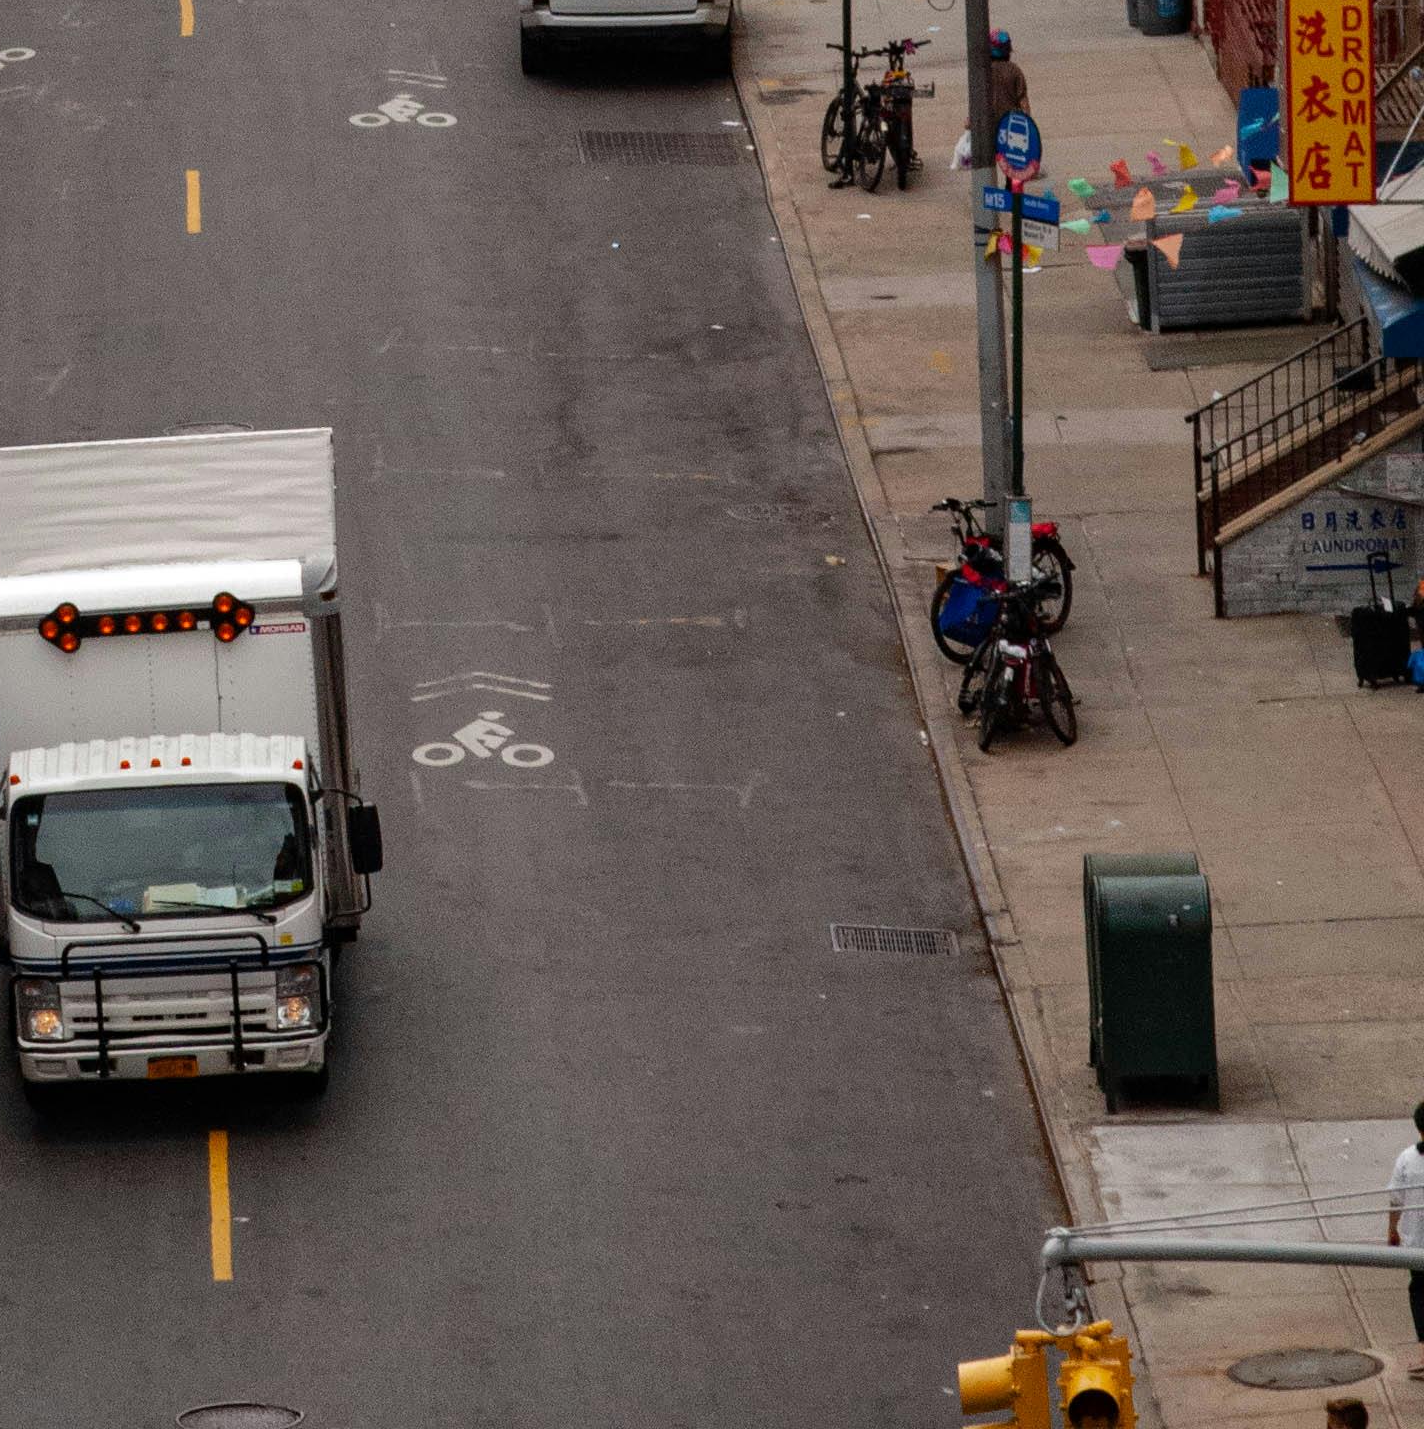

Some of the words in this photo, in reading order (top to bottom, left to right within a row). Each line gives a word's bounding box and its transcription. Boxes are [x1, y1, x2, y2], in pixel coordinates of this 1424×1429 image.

[1301, 506, 1408, 532] 日月洗衣店
[1302, 537, 1408, 553] LAUNDROMAT
